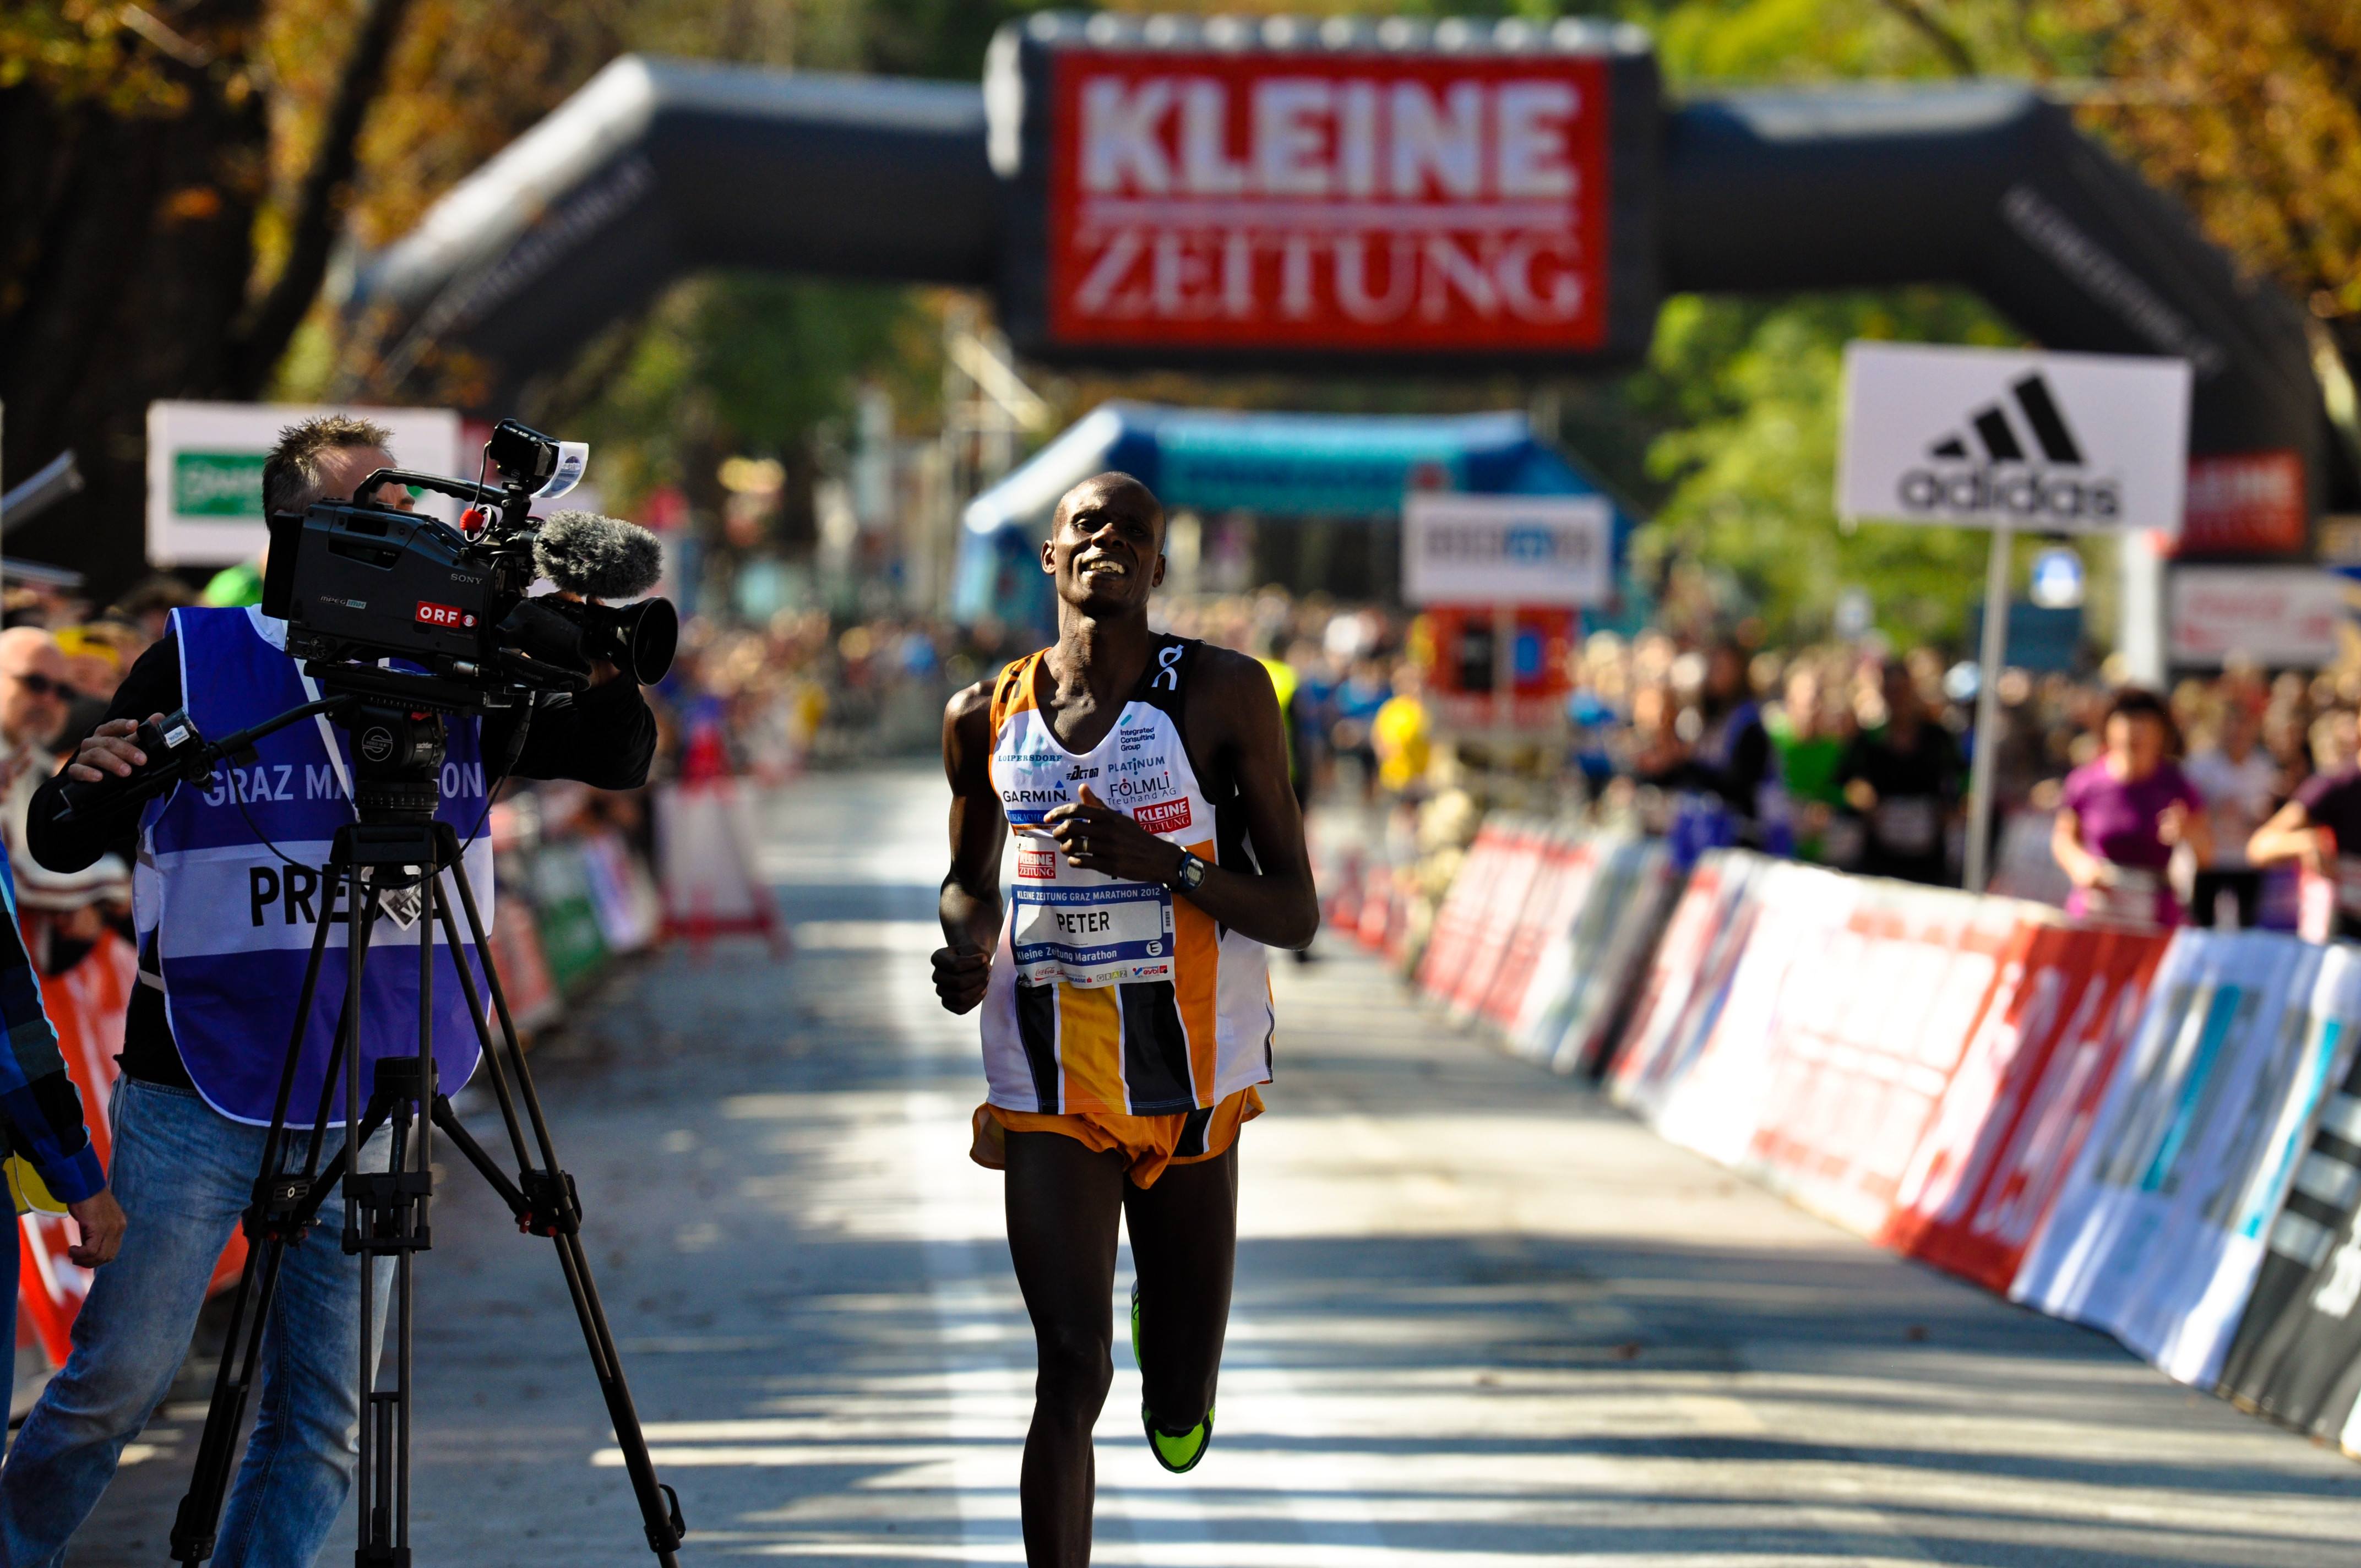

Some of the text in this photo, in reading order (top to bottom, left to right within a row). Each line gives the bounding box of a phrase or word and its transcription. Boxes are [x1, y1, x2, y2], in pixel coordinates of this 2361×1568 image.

[1077, 72, 1582, 199] KLEINE
[1075, 228, 1584, 326] ZEITUNG
[1898, 466, 2121, 518] adidas
[450, 573, 483, 585] SONY
[420, 606, 458, 624] ORF
[1120, 727, 1155, 736] Integrated
[1120, 734, 1155, 744] Consulting
[202, 762, 482, 807] GRAZ MAON
[1107, 787, 1177, 805] Treuhand AG
[1137, 801, 1188, 822] KLEINE
[1141, 815, 1189, 832] ZEITUNG
[1019, 854, 1053, 865] KLEINE
[1019, 867, 1054, 876] ZEITUNG
[1017, 888, 1161, 901] KLEINE ZEITUNG GRAZ MARATHON 2012
[1056, 911, 1110, 934] PETER
[1016, 947, 1117, 962] Kleine Zeitung Marathon
[1097, 970, 1127, 981] GRAZ
